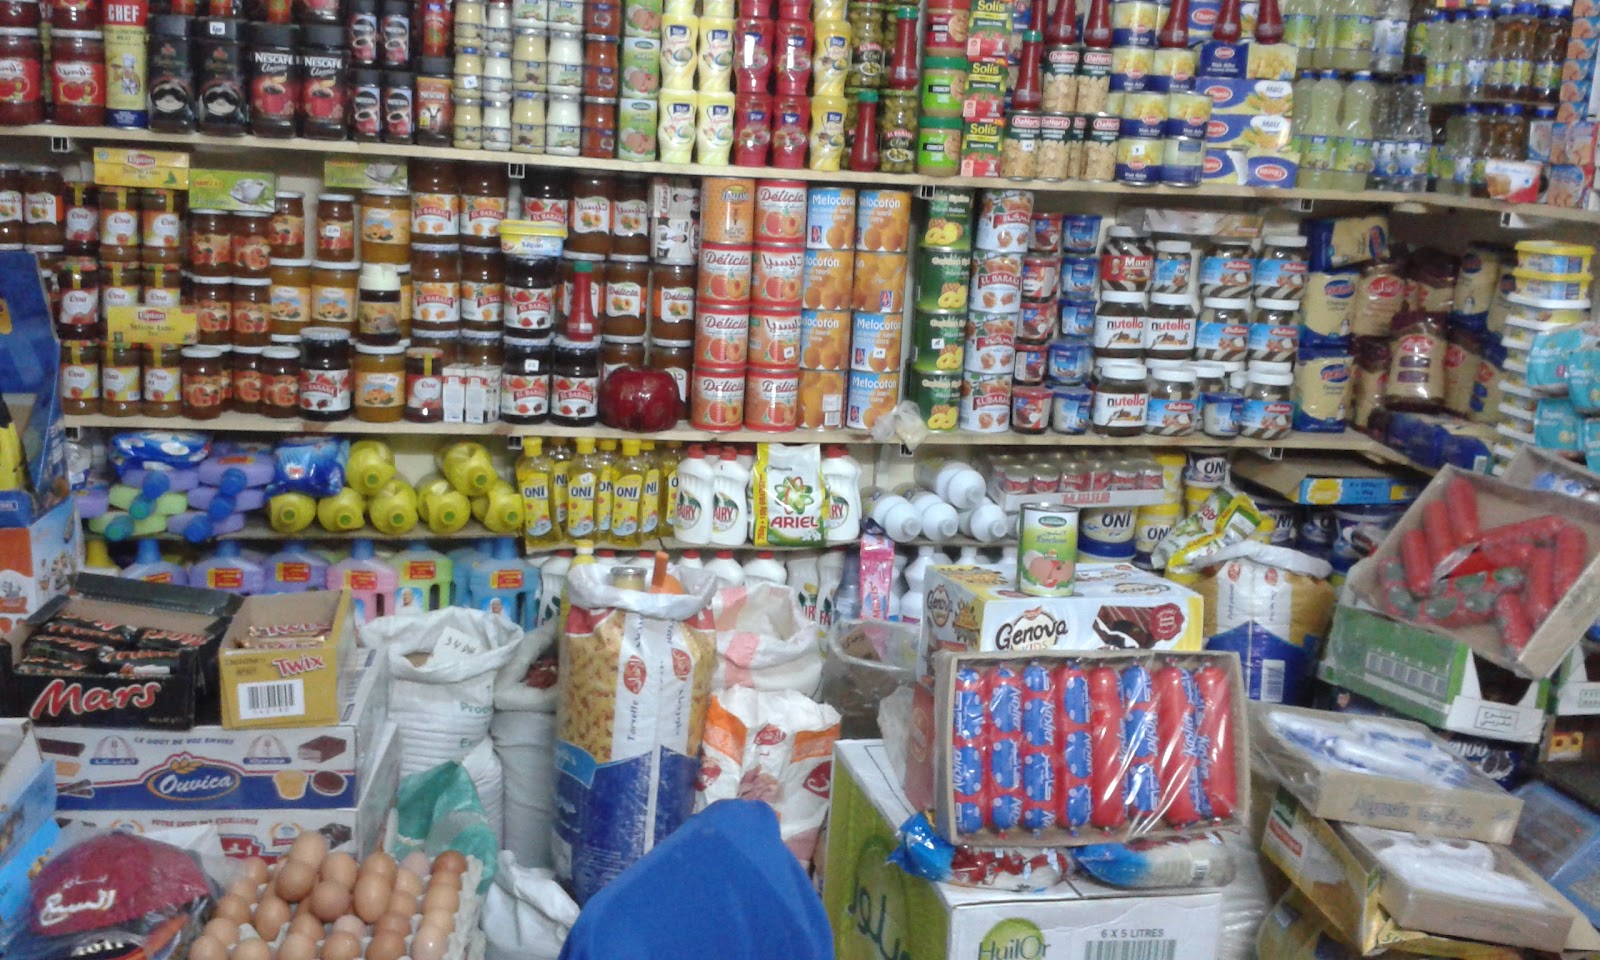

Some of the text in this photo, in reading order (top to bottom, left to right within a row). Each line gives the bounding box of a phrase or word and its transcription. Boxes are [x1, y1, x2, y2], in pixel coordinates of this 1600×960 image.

[108, 4, 140, 23] CHEF
[128, 156, 156, 166] Lipton
[761, 187, 804, 202] Délicia
[706, 251, 750, 266] Délicia
[981, 277, 990, 285] EL
[608, 286, 639, 297] Délicia
[138, 311, 166, 321] Lipton
[705, 316, 747, 330] Délicia
[1107, 318, 1144, 330] nutella
[1152, 319, 1191, 331] nutella
[1107, 395, 1146, 407] nutella
[524, 486, 546, 498] ONI
[571, 486, 592, 498] ONI
[616, 486, 638, 497] ONI
[713, 506, 734, 521] AIRY
[1102, 509, 1133, 528] ONI
[769, 515, 819, 529] ARIEL
[995, 620, 1069, 651] Genova
[273, 654, 325, 678] Twix
[30, 679, 162, 720] Mars
[1009, 686, 1022, 732] Kasher
[1042, 699, 1055, 745] Kasher
[1147, 710, 1160, 756] Kasher
[159, 774, 233, 795] Ouvica
[1101, 928, 1164, 938] 6 X 5 LITRES
[978, 935, 1051, 960] HuilOr
